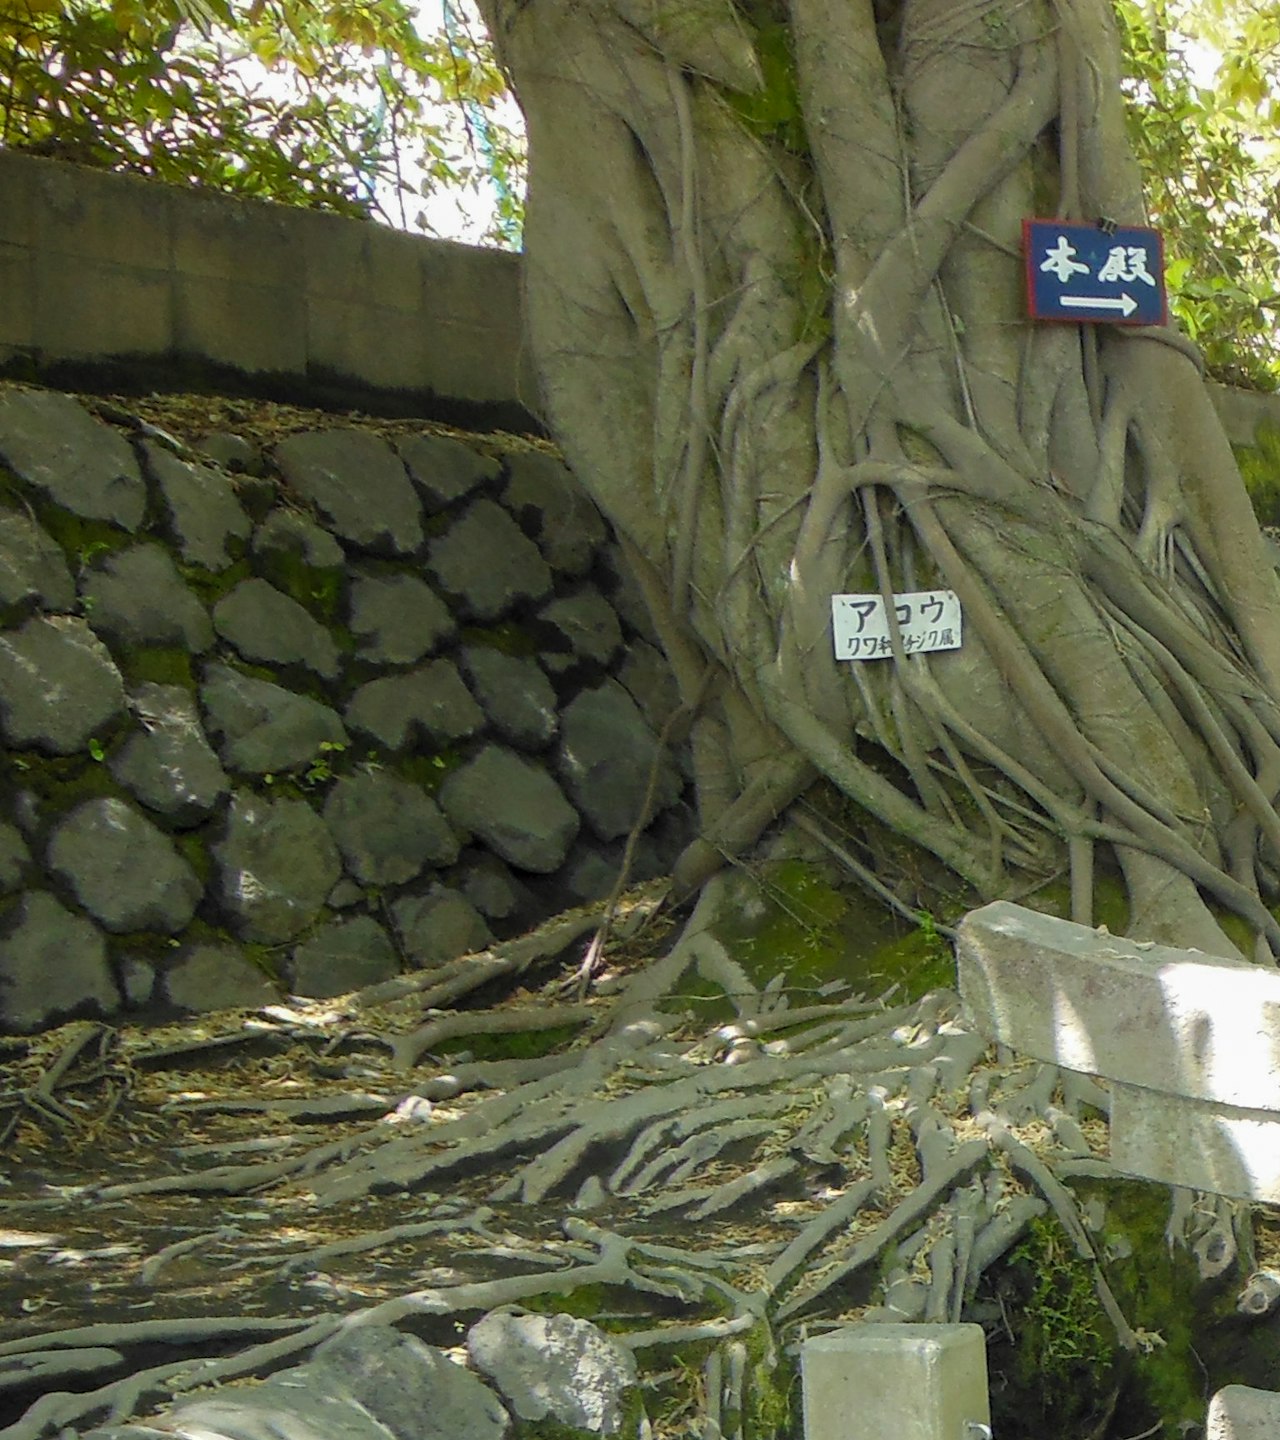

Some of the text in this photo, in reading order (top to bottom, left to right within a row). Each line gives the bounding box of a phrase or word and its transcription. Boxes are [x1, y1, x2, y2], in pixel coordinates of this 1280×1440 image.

[1039, 235, 1156, 287] 本殿
[849, 595, 945, 633] アコウ
[847, 627, 955, 657] クワ科チジク属
